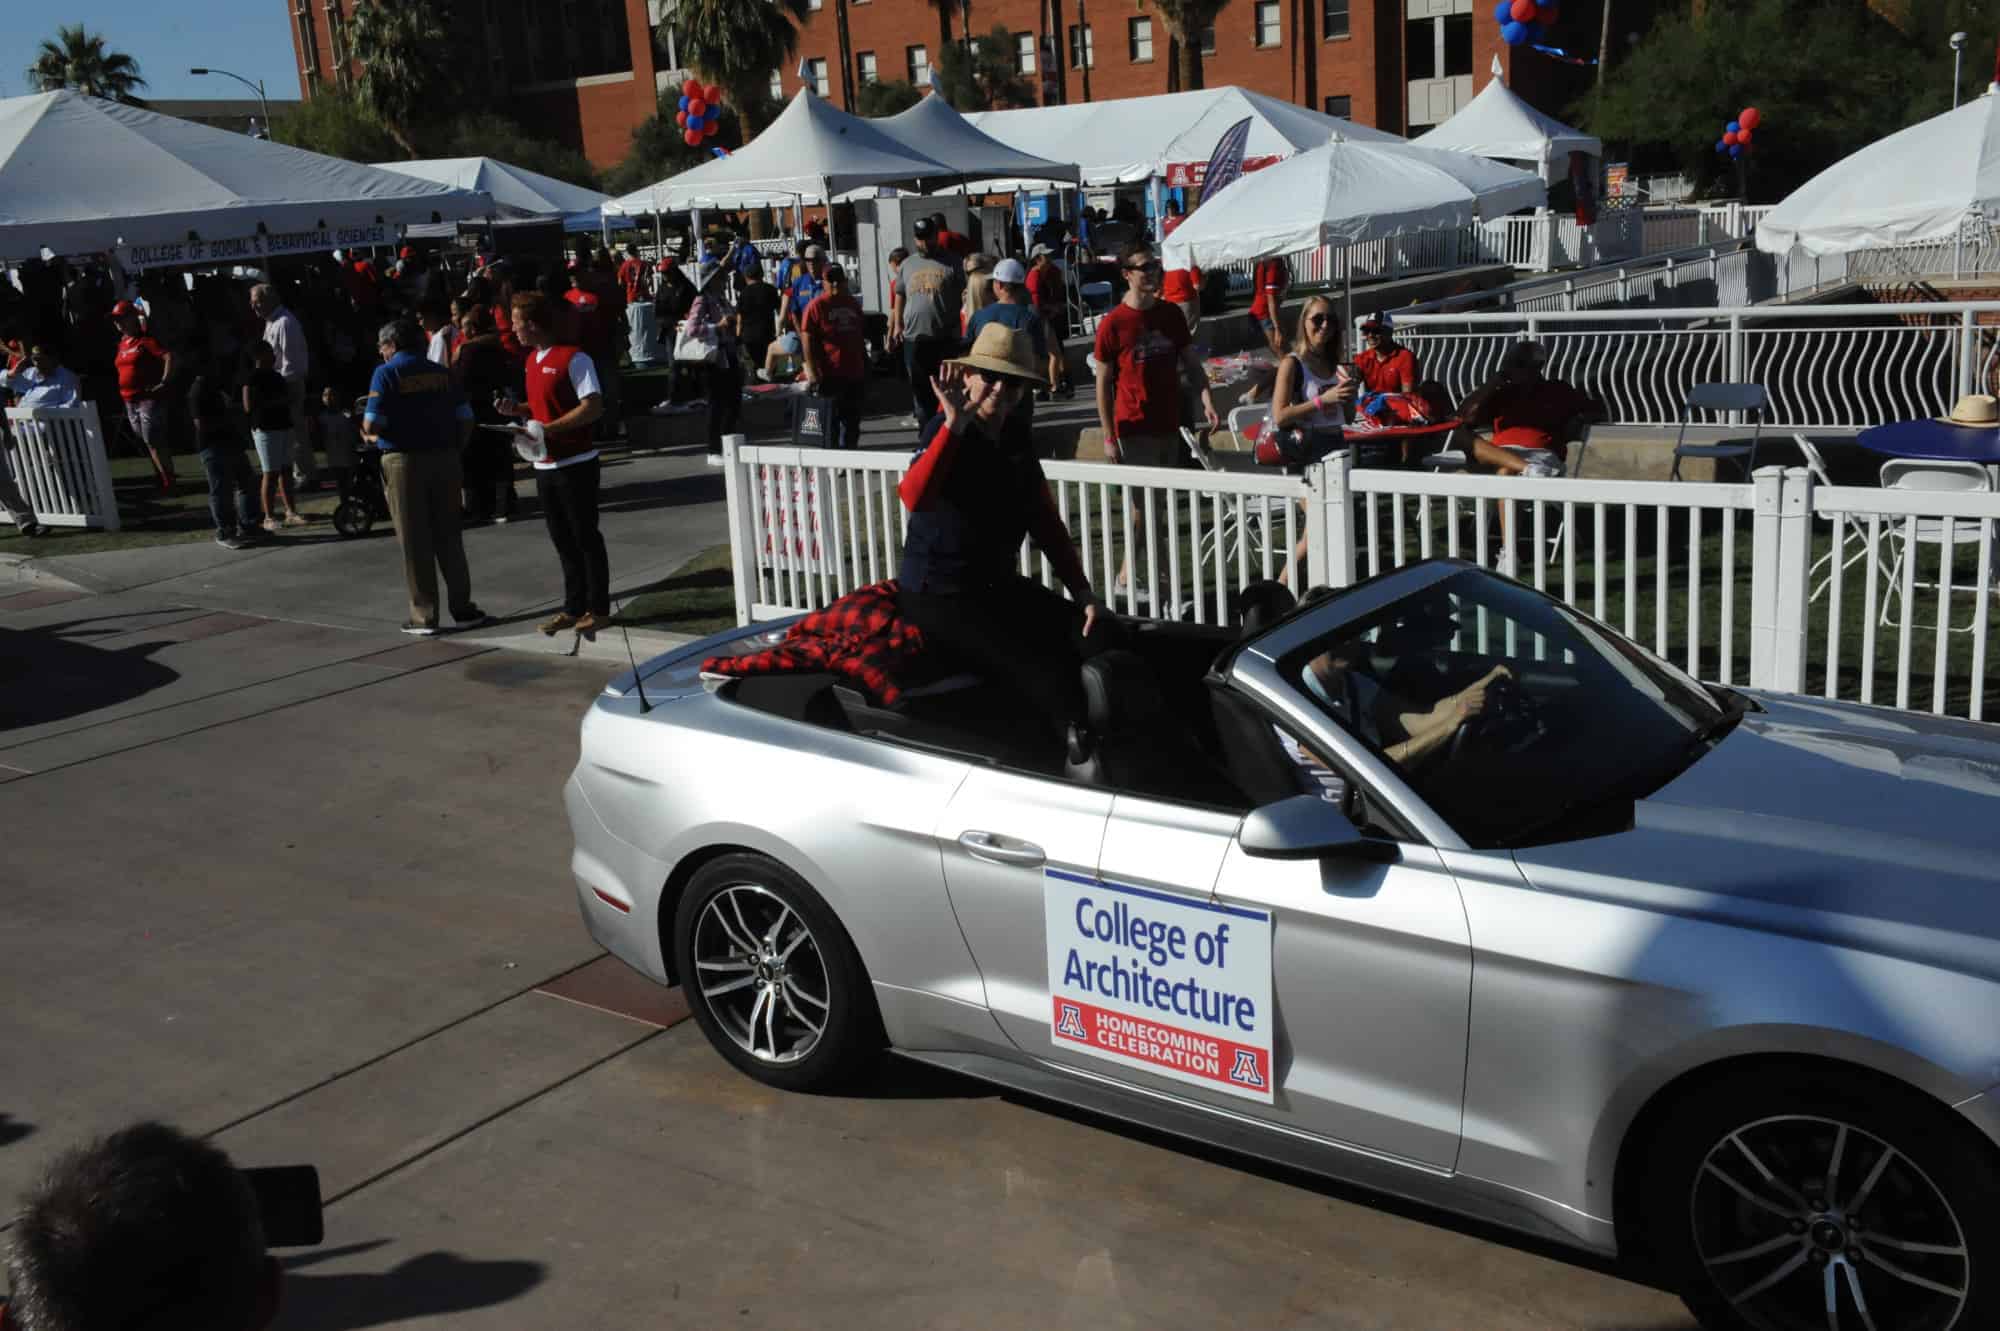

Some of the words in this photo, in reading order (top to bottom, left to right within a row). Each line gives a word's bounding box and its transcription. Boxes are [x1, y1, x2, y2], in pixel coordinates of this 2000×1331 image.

[130, 245, 183, 265] COLLEGE
[189, 243, 205, 259] OF
[210, 239, 249, 258] SOCIAL
[267, 232, 332, 251] BEHAVIORAL
[336, 227, 385, 245] SCIENCES
[1075, 897, 1186, 967] College
[1194, 923, 1230, 969] of
[1063, 948, 1256, 1032] Architecture
[1058, 1004, 1087, 1039] A
[1096, 1012, 1220, 1058] HOMECOMING
[1096, 1028, 1220, 1075] CELEBRATION
[1229, 1048, 1264, 1086] A
